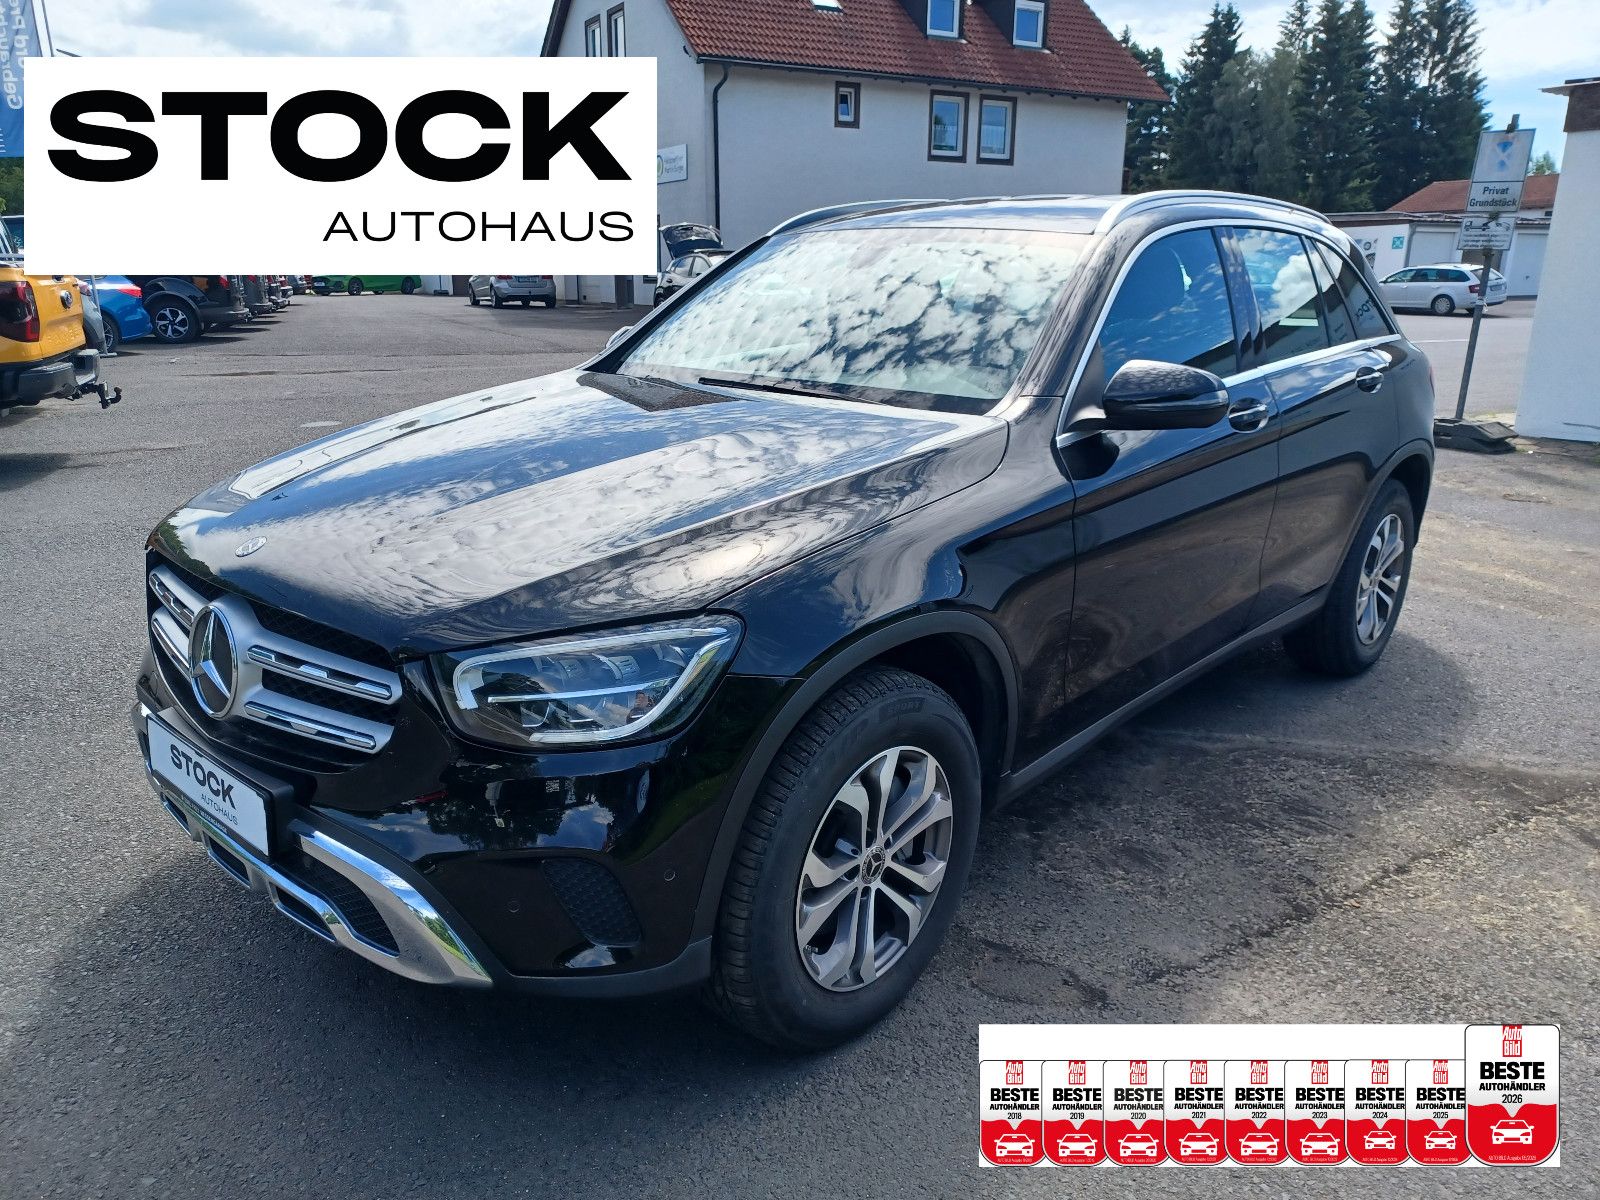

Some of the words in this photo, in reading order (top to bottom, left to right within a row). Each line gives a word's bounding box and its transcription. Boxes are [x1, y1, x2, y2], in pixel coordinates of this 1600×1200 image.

[1482, 186, 1509, 195] Privat
[1469, 198, 1517, 207] Grundstück
[170, 743, 236, 811] STOCK
[201, 793, 239, 826] AUTOHAUS
